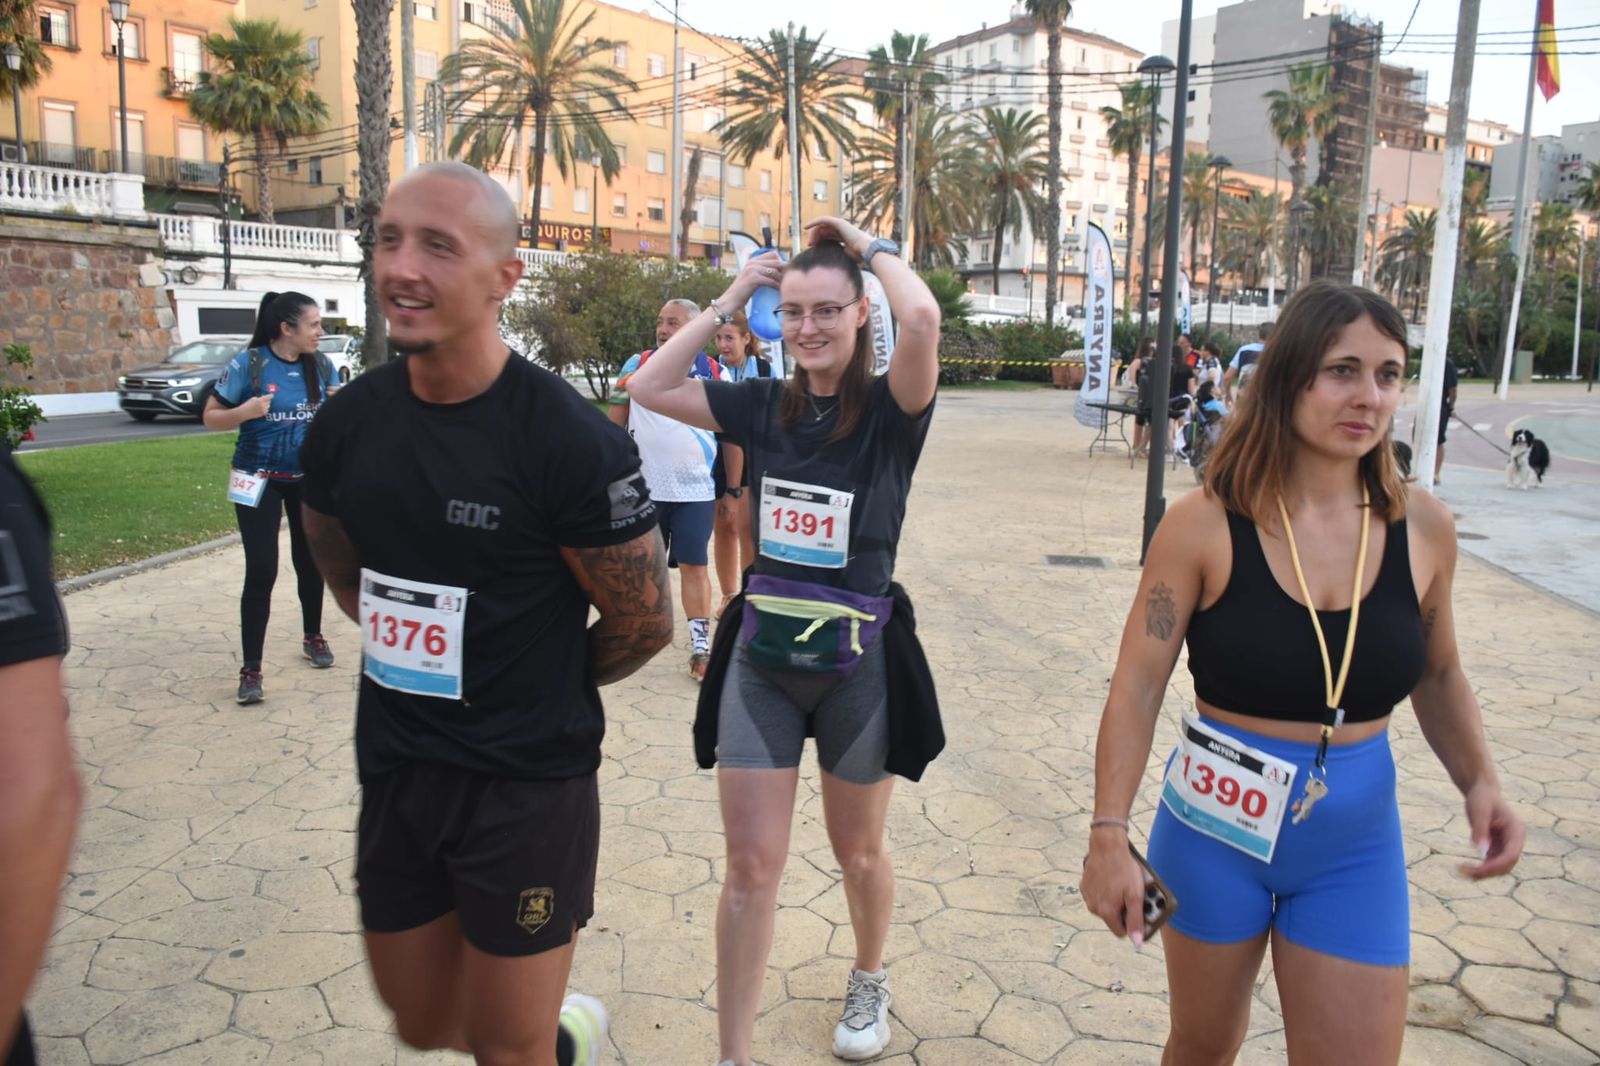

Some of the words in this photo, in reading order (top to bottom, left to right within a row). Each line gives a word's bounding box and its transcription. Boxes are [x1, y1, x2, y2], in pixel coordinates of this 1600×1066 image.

[446, 498, 501, 531] GOC
[772, 507, 834, 539] 1391
[369, 611, 448, 656] 1376
[1183, 754, 1268, 818] 1390
